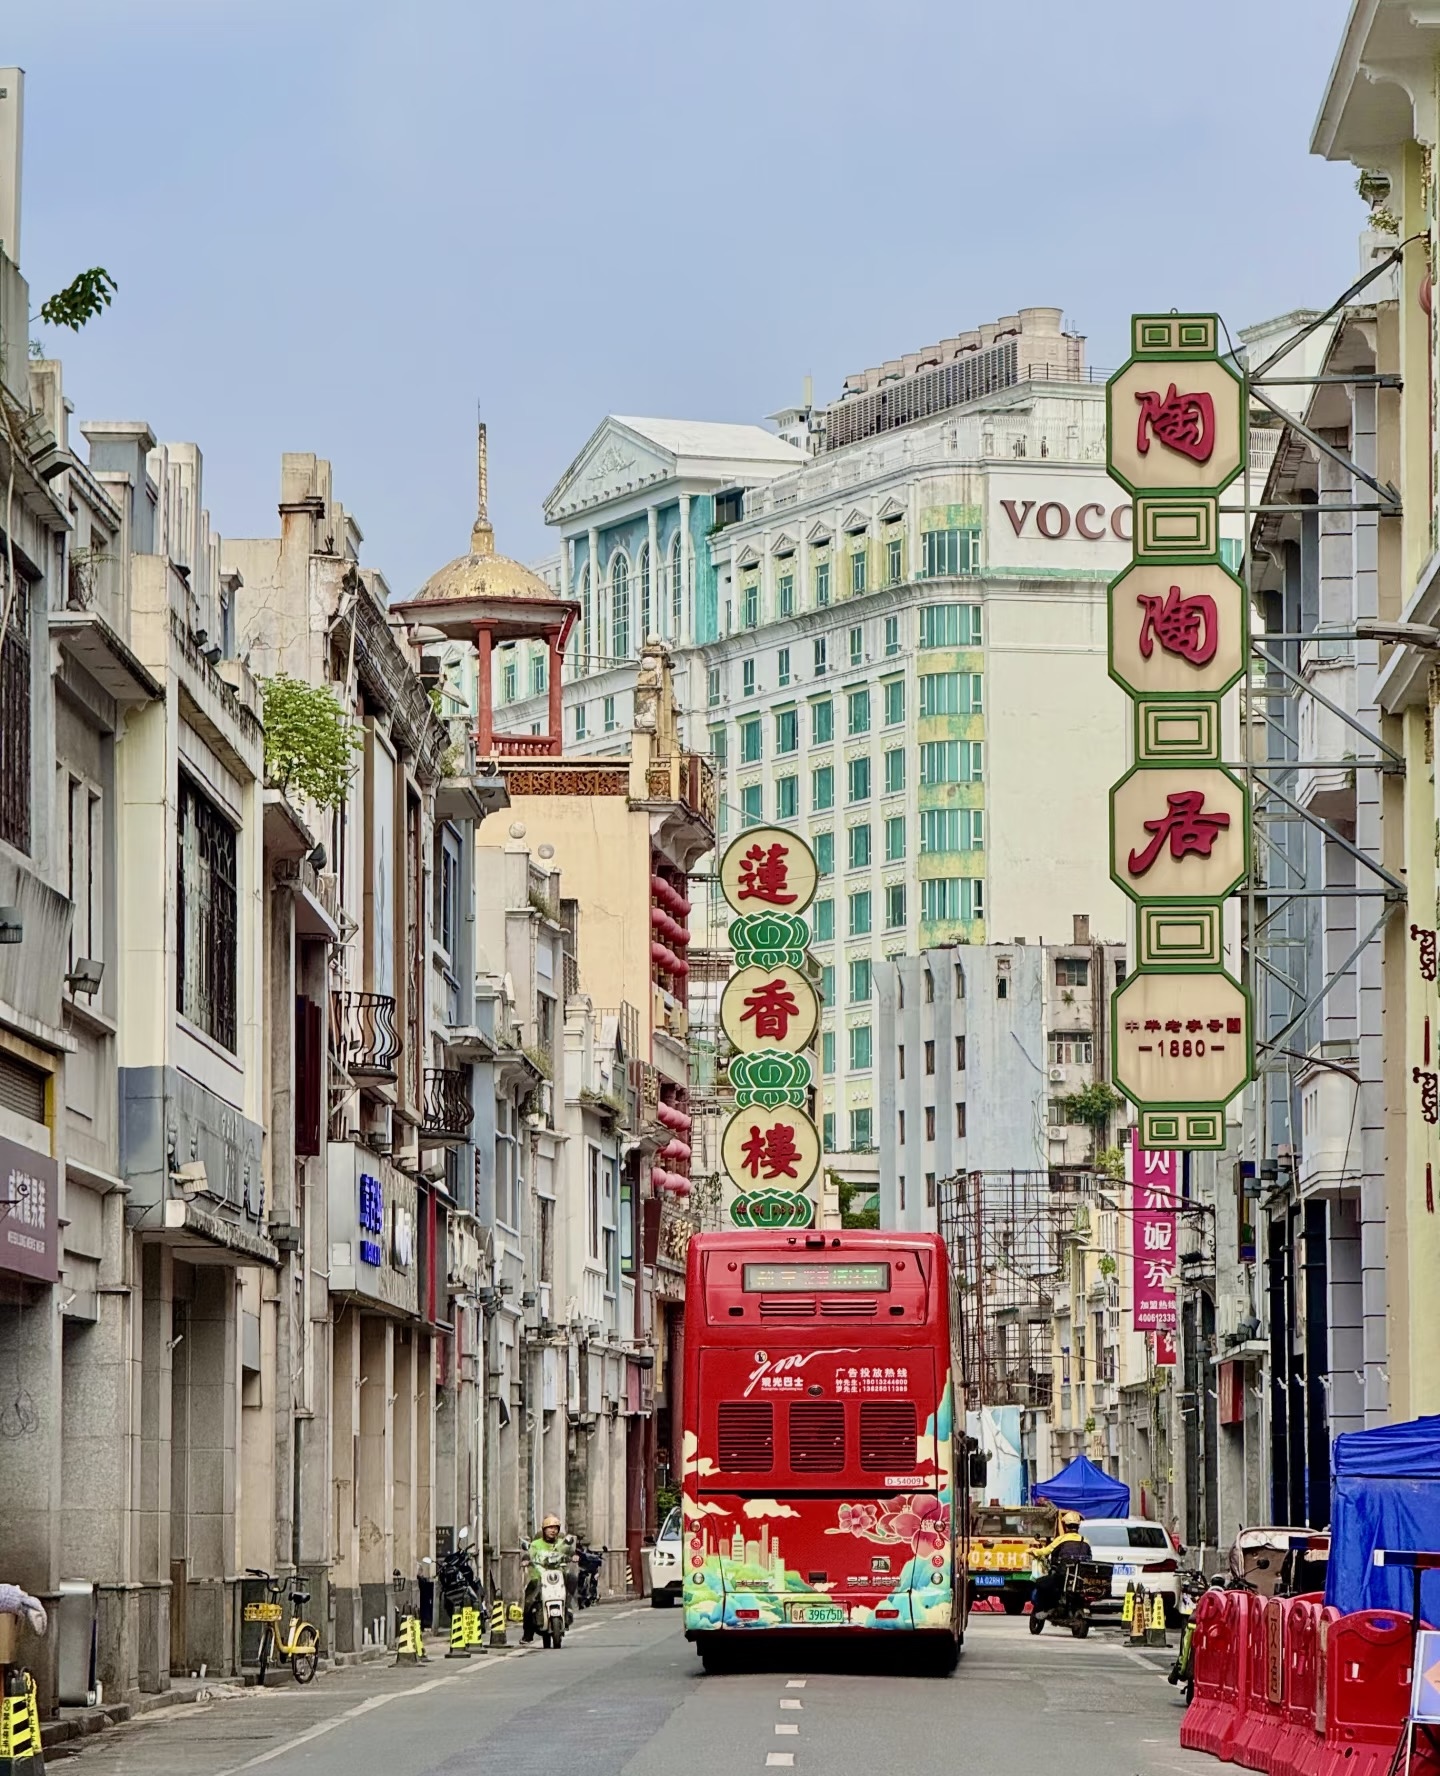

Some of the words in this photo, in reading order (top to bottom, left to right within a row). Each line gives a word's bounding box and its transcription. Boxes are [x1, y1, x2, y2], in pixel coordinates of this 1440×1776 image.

[1128, 383, 1231, 874] 陶陶居
[737, 843, 803, 1180] 蓮香樓
[1158, 1039, 1206, 1058] 1880
[835, 1367, 908, 1378] 广告投放热线
[887, 1477, 921, 1485] D-54009
